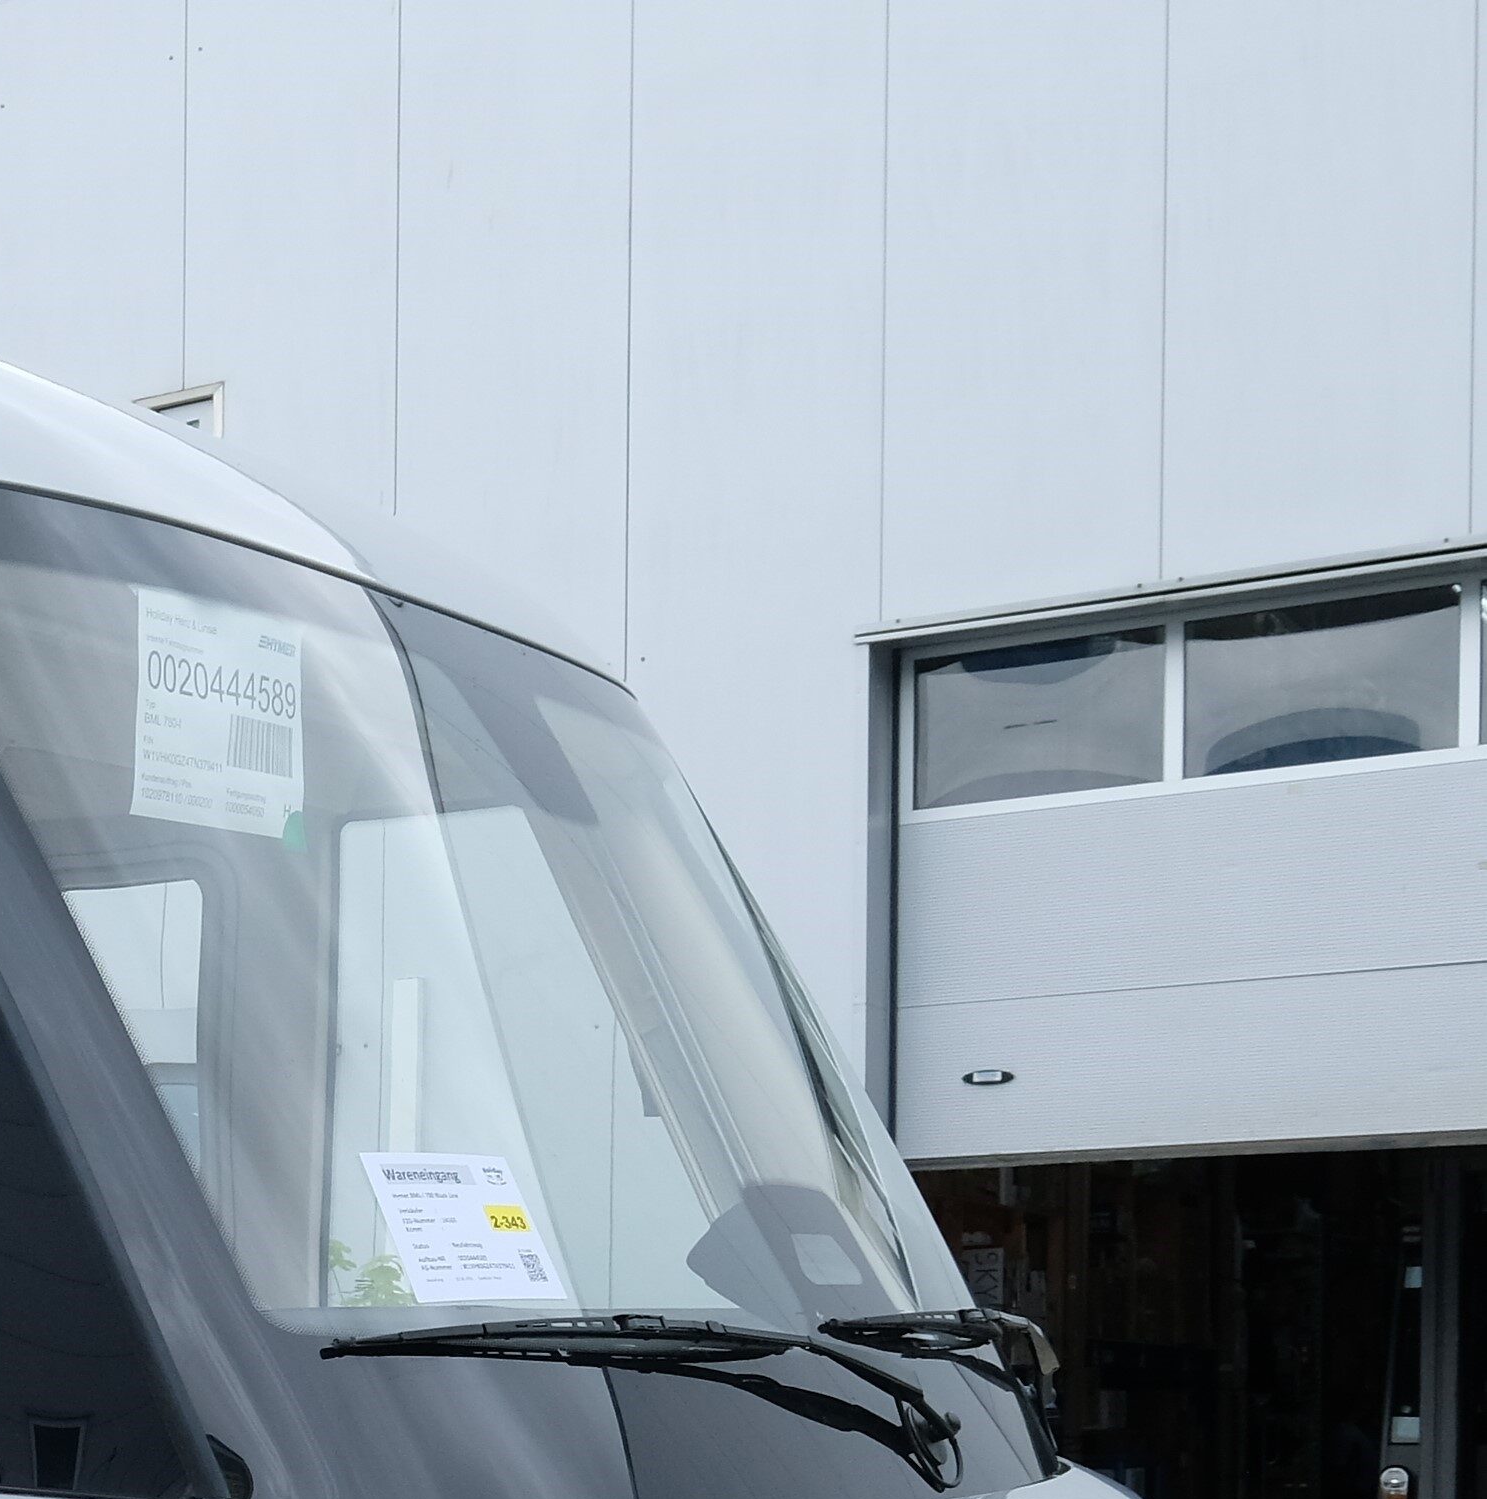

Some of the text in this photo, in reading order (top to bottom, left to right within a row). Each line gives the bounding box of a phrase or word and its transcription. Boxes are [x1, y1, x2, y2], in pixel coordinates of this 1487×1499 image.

[148, 650, 296, 719] 0020444589
[382, 1167, 462, 1184] Wareneingang
[490, 1215, 527, 1230] 2-343
